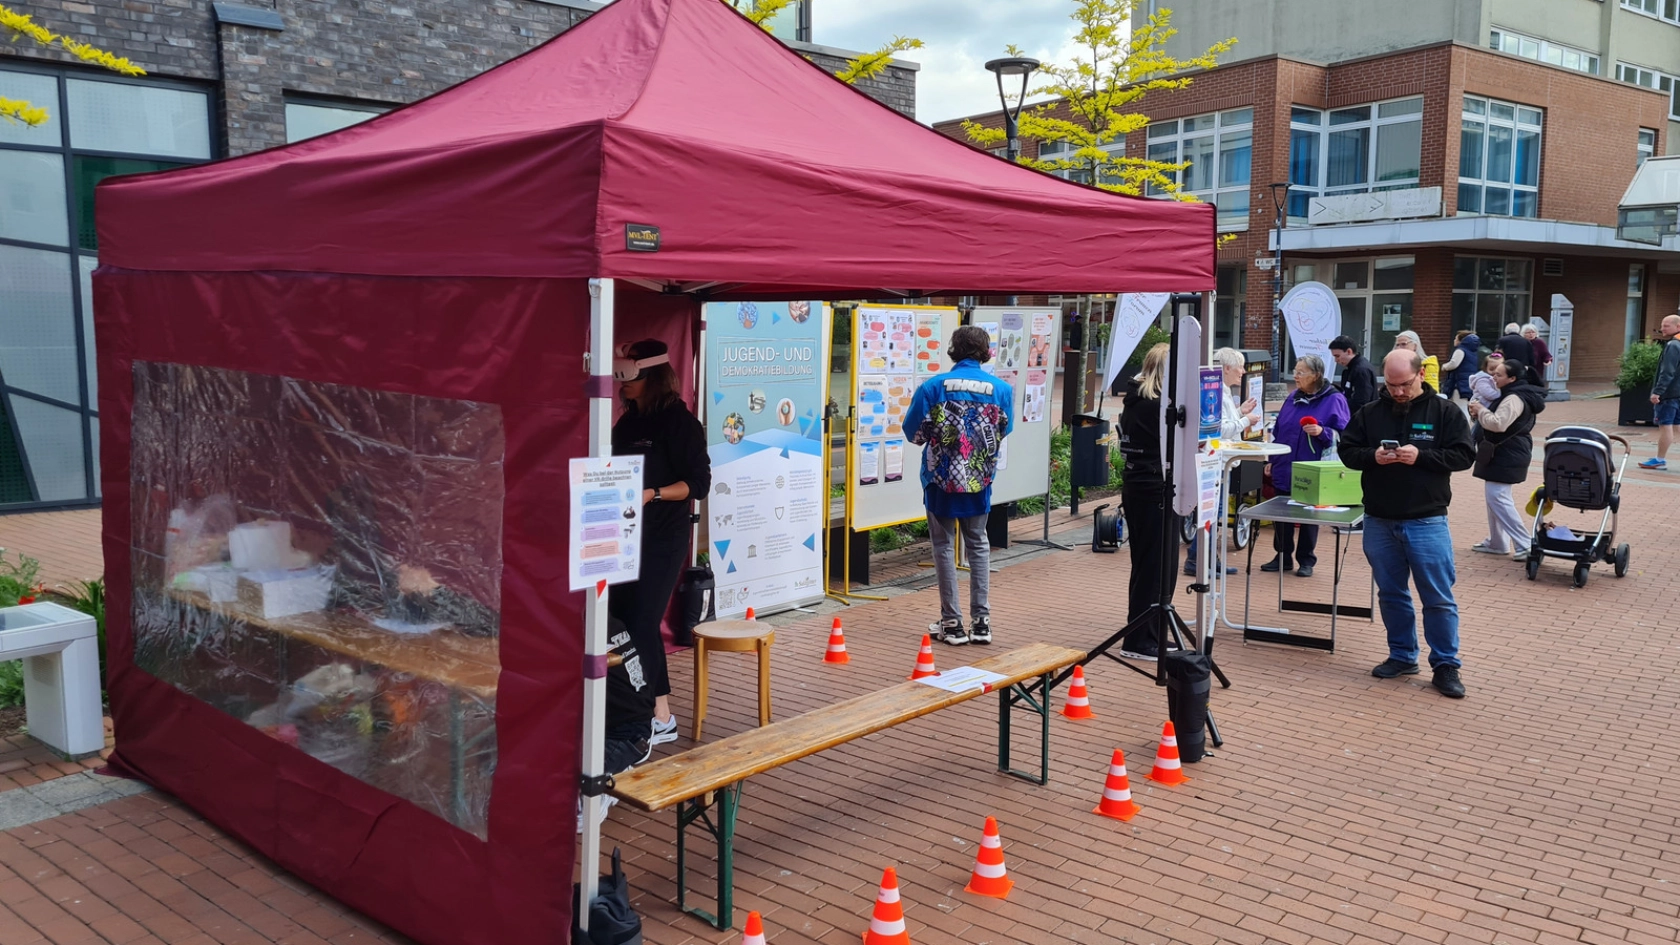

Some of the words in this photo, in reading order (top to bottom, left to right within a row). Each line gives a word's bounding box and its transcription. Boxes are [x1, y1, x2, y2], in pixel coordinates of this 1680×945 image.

[722, 347, 780, 362] JUGEND-
[784, 347, 812, 361] UND
[722, 365, 813, 377] DEMOKRATIEBILDUNG
